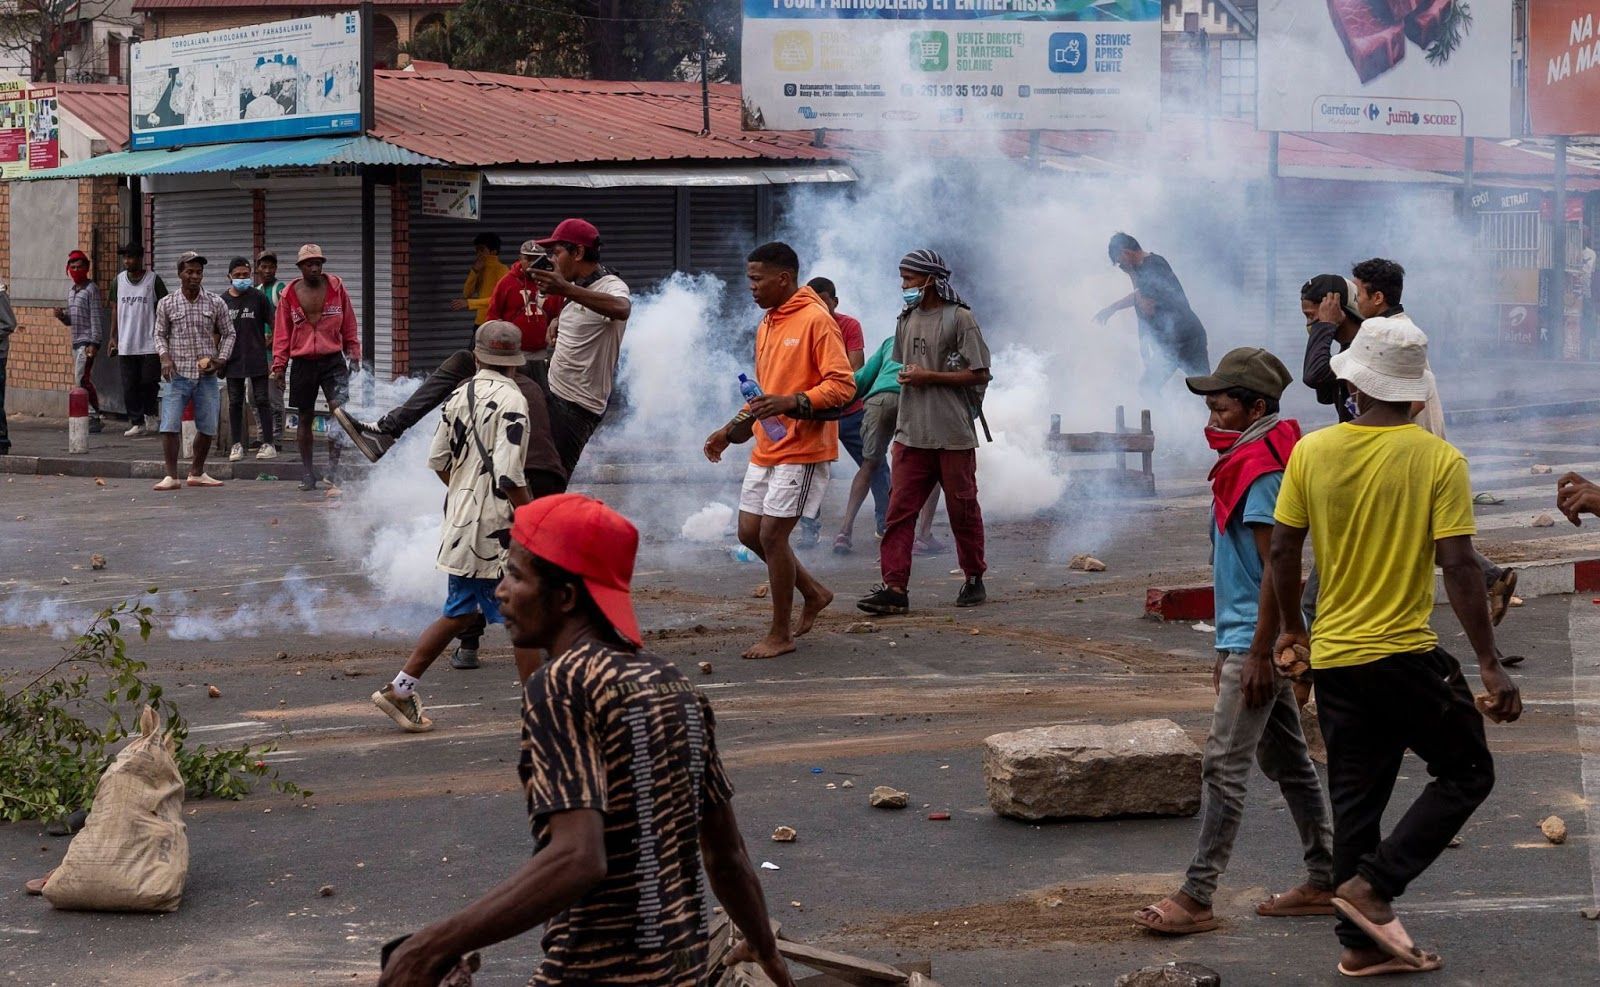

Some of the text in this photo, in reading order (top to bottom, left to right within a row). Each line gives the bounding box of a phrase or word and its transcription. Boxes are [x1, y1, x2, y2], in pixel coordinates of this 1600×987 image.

[1569, 13, 1593, 46] NA
[956, 33, 1023, 45] VENTE DIRECTE
[1095, 34, 1131, 46] SERVICE
[956, 46, 969, 57] DE
[956, 60, 993, 71] SOLAIRE
[1095, 60, 1122, 72] VENTE
[1547, 51, 1571, 85] NA
[956, 85, 968, 96] 35
[971, 85, 988, 96] 123
[991, 85, 1003, 96] 40
[1321, 103, 1360, 115] Carrefour
[1423, 113, 1457, 125] SCORE
[913, 337, 926, 355] FG
